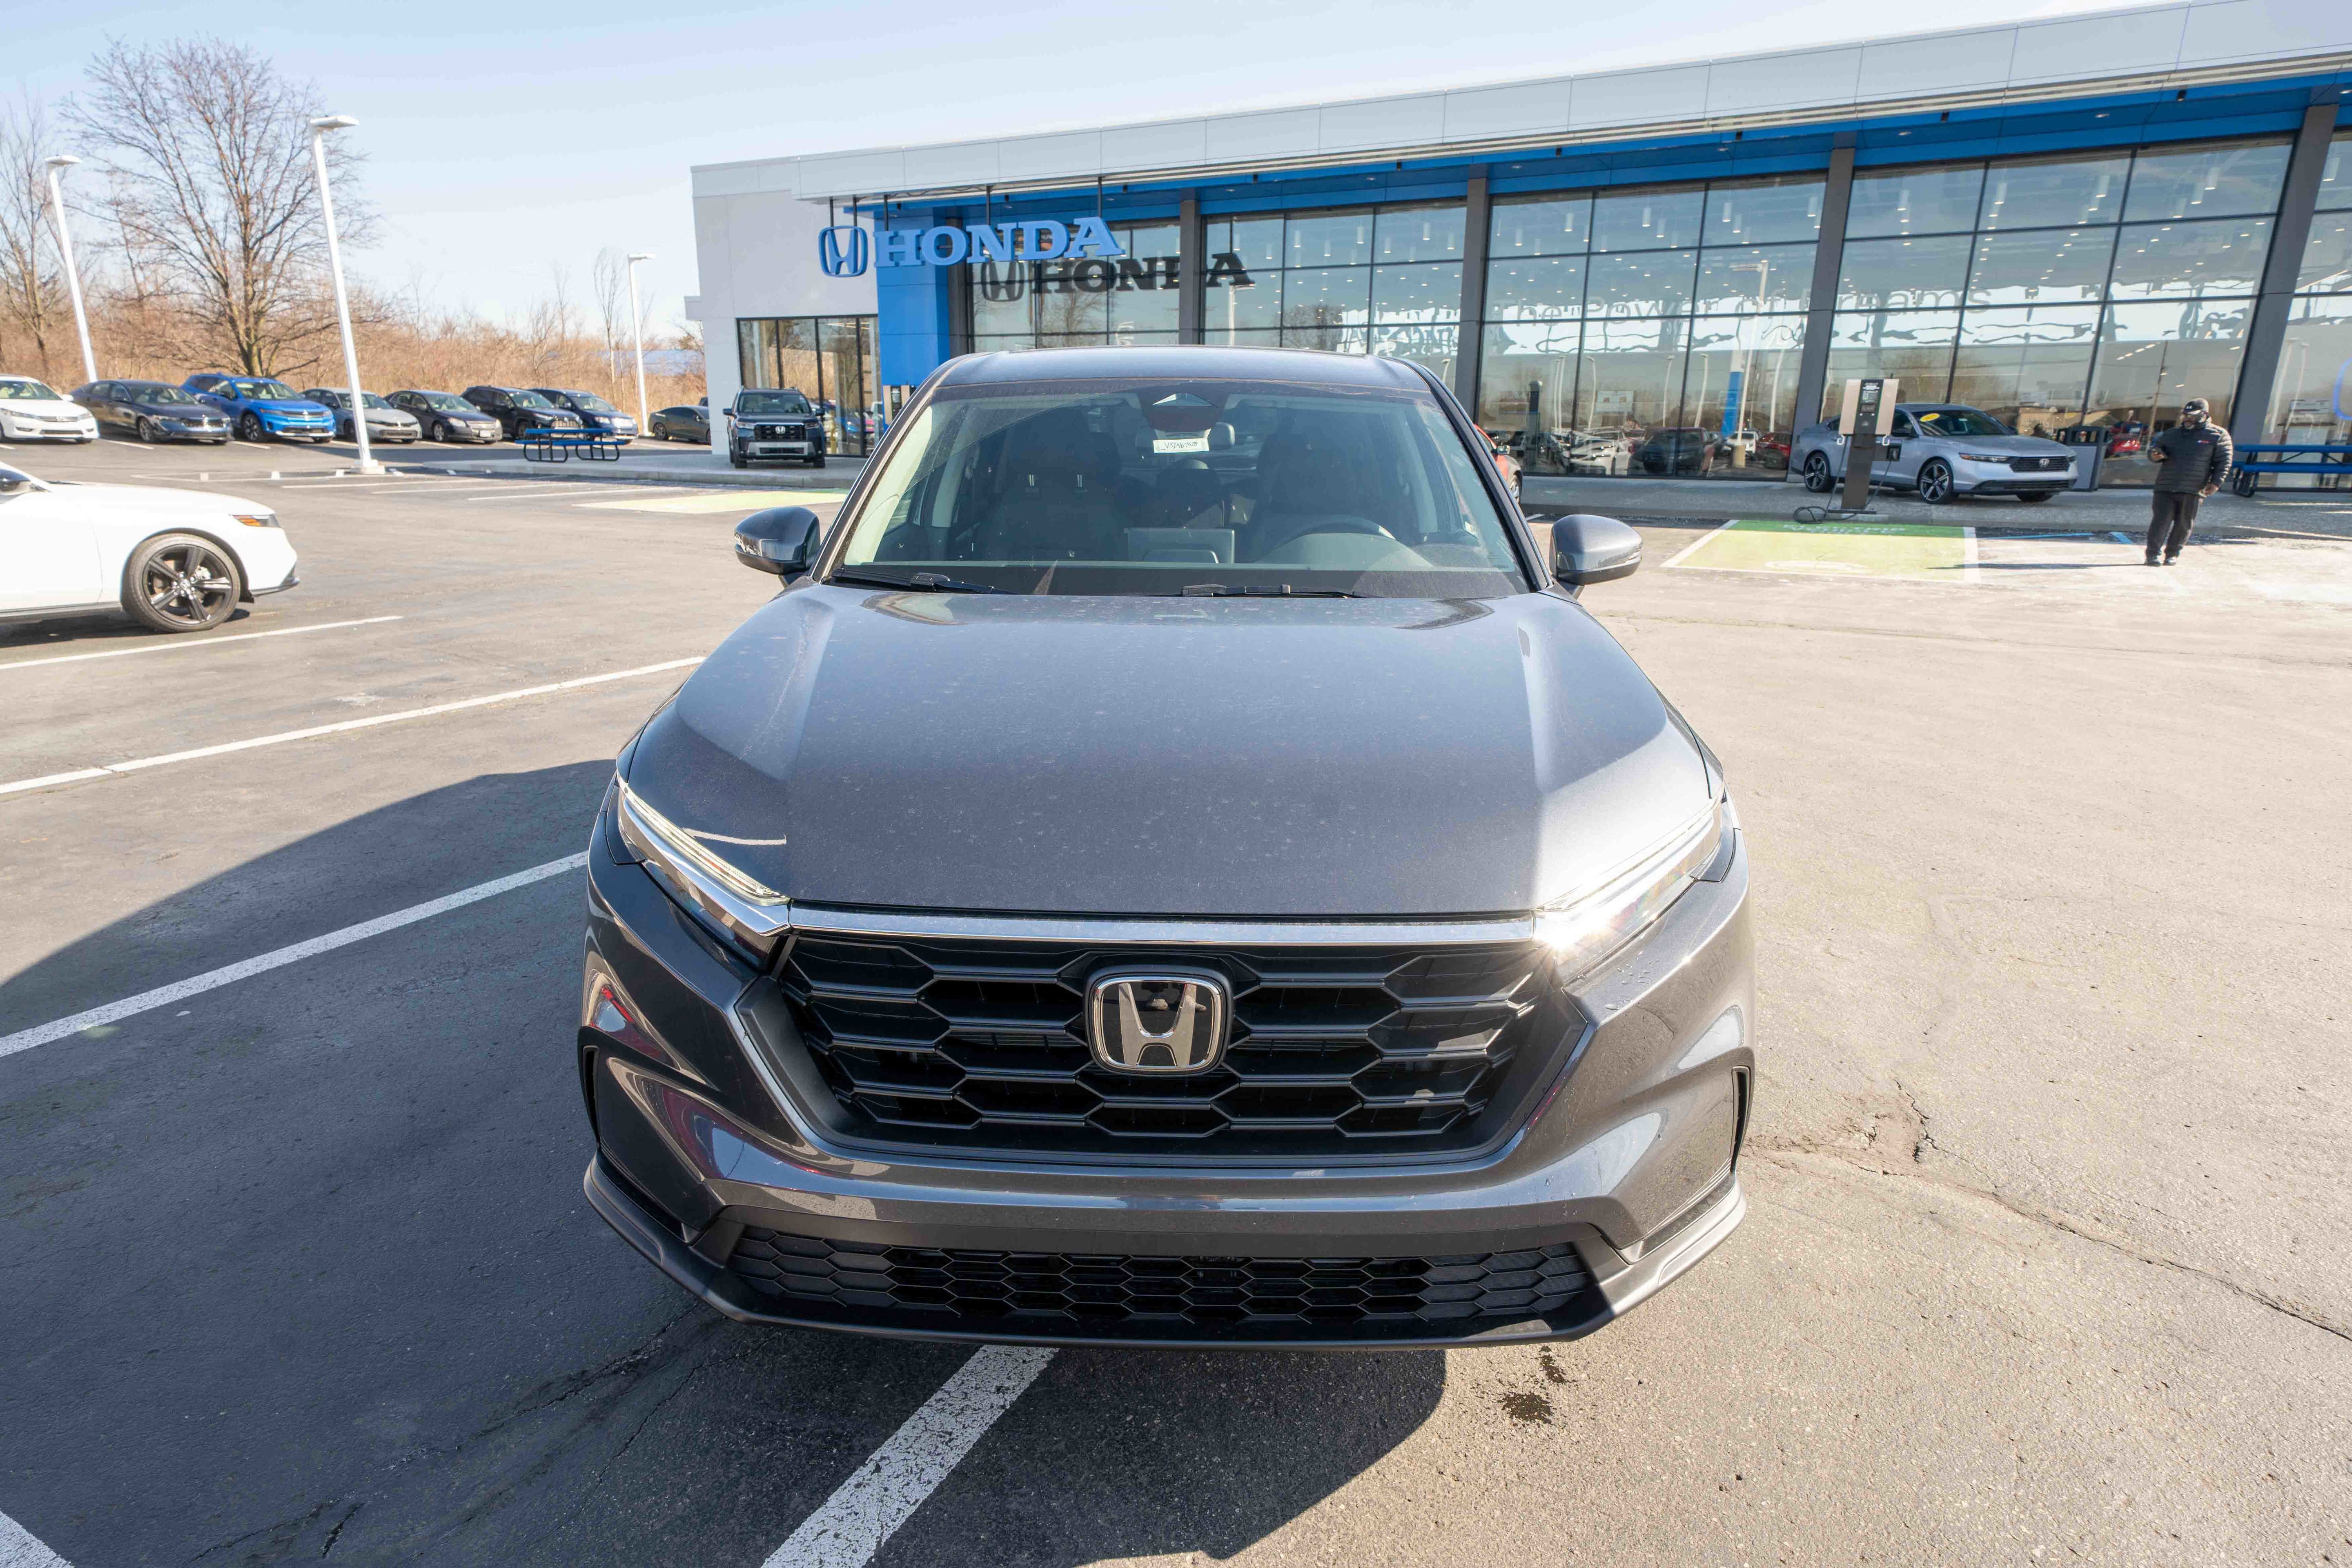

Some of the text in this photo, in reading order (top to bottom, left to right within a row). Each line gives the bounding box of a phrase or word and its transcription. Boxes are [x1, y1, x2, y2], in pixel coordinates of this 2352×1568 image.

[873, 217, 1126, 267] HONDA
[1492, 287, 1992, 327] The Power of reams
